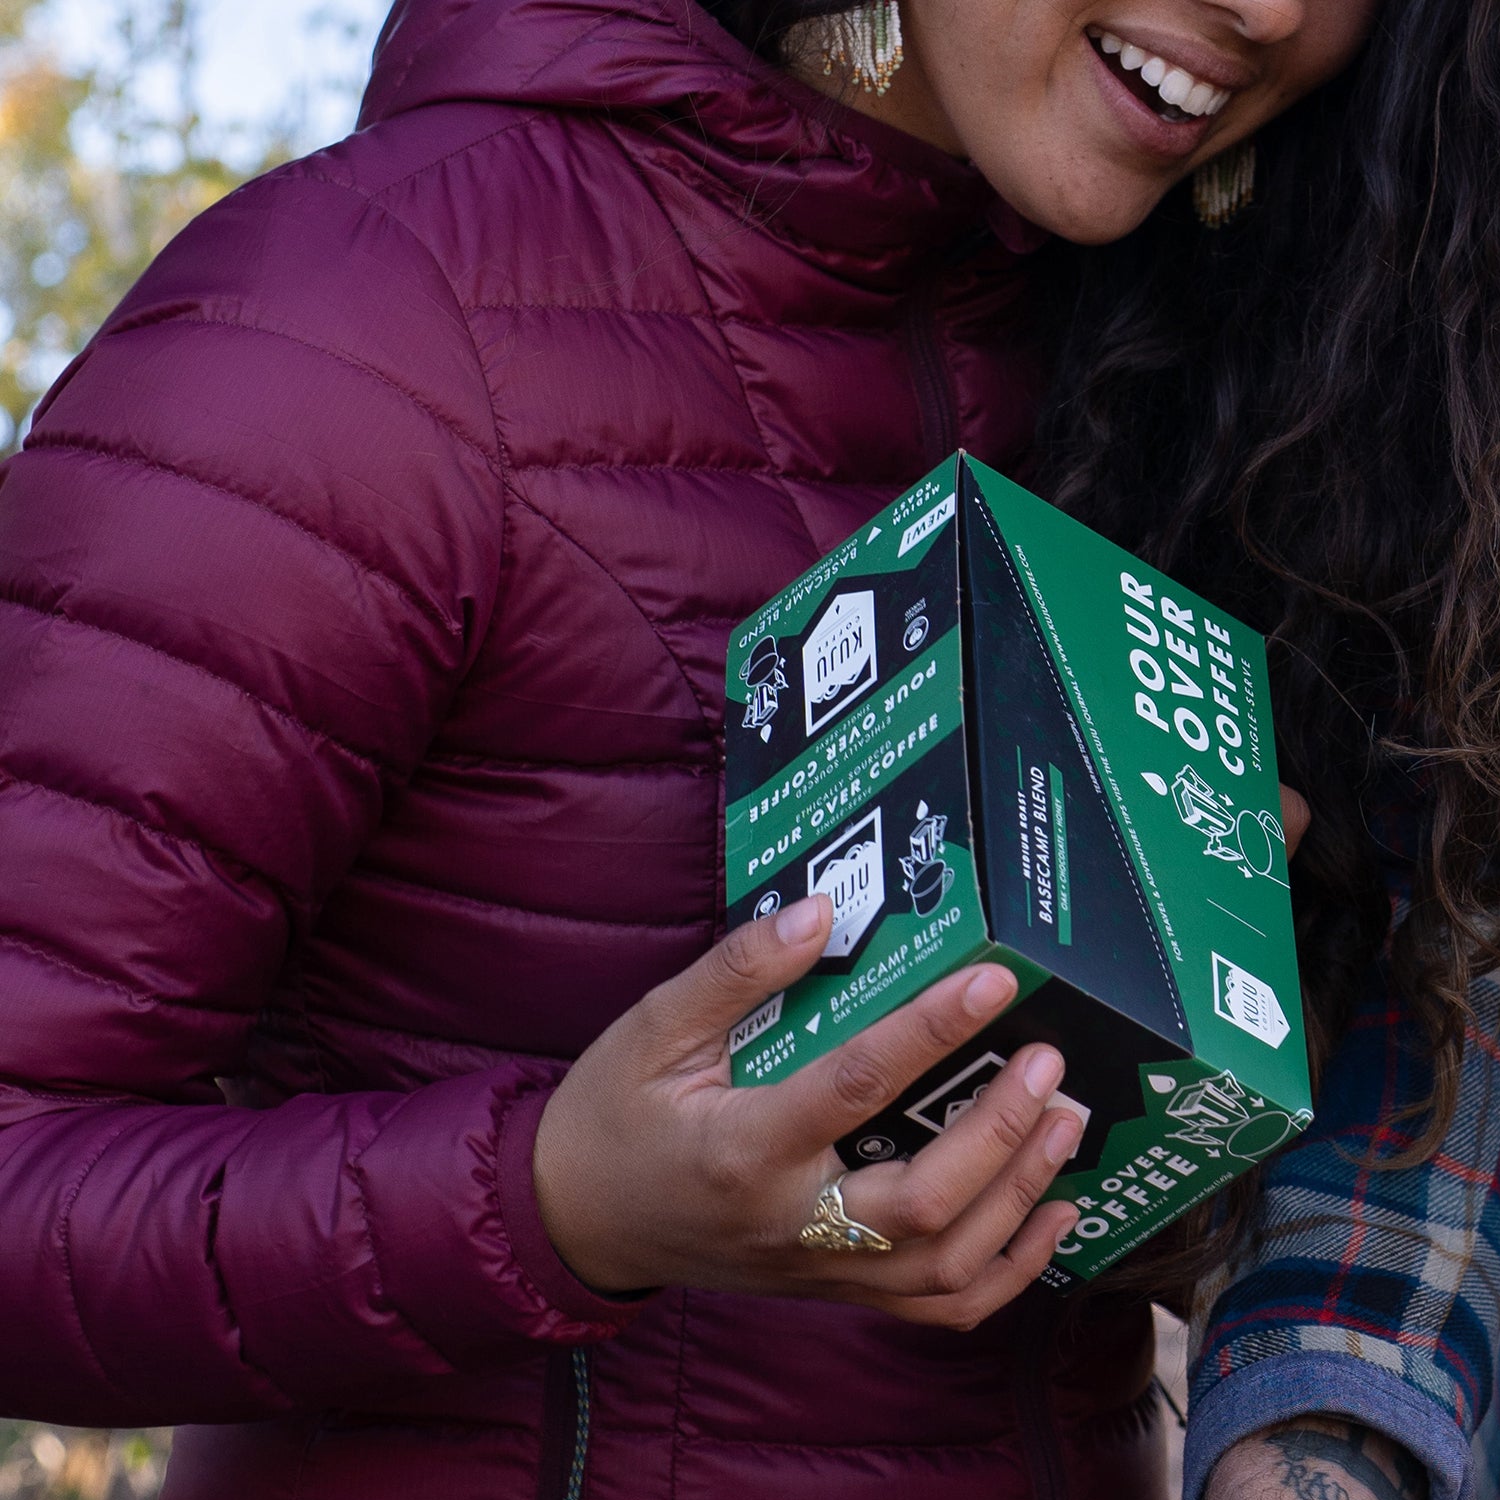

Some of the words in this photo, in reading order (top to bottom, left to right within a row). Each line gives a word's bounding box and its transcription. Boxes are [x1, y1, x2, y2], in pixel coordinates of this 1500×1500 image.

[892, 483, 940, 525] MEDIUM
[893, 481, 931, 515] ROAST
[906, 504, 947, 544] NEW!
[784, 547, 857, 611] BASECAMP
[739, 609, 779, 648] BLEND
[1120, 571, 1170, 733] POUR
[817, 625, 862, 683] KUJU
[1160, 596, 1210, 752] OVER
[884, 660, 937, 712] POUR
[1071, 681, 1094, 726] JOURNAL
[1204, 617, 1245, 776] COFFEE
[826, 713, 876, 761] OVER
[843, 715, 892, 761] ETHICALLY
[1240, 657, 1262, 772] SINGLE-SERVE
[1089, 727, 1104, 754] KUJU
[795, 759, 840, 799] SOURCED
[795, 779, 844, 823] ETHICALLY
[848, 740, 892, 780] SOURCED
[1100, 755, 1112, 775] THE
[748, 826, 802, 876] POUR
[811, 778, 861, 827] OVER
[869, 713, 939, 779] COFFEE
[750, 761, 818, 823] COFFEE
[1017, 790, 1029, 830] ROAST
[1029, 765, 1048, 823] BLEND
[1109, 777, 1123, 803] VISIT
[1119, 804, 1132, 827] TIPS
[1020, 832, 1032, 879] MEDIUM
[1034, 825, 1053, 924] BASECAMP
[1057, 836, 1069, 883] CHOCOLATE
[1129, 829, 1157, 888] ADVENTURE
[828, 863, 869, 909] UJU
[1157, 902, 1175, 937] TRAVEL
[829, 945, 908, 1012] BASECAMP
[914, 907, 962, 951] BLEND
[1171, 939, 1183, 962] FOR
[833, 1007, 852, 1025] OAK
[859, 962, 908, 1005] CHOCOLATE
[914, 936, 944, 965] HONEY
[1241, 980, 1260, 1027] KUJU
[733, 1003, 778, 1047] NEW!
[745, 1030, 795, 1074] MEDIUM
[755, 1043, 797, 1080] ROAST
[1101, 1145, 1171, 1192] OVER
[1055, 1155, 1200, 1254] COFFEE
[1109, 1195, 1169, 1238] SINGLE-SERVE
